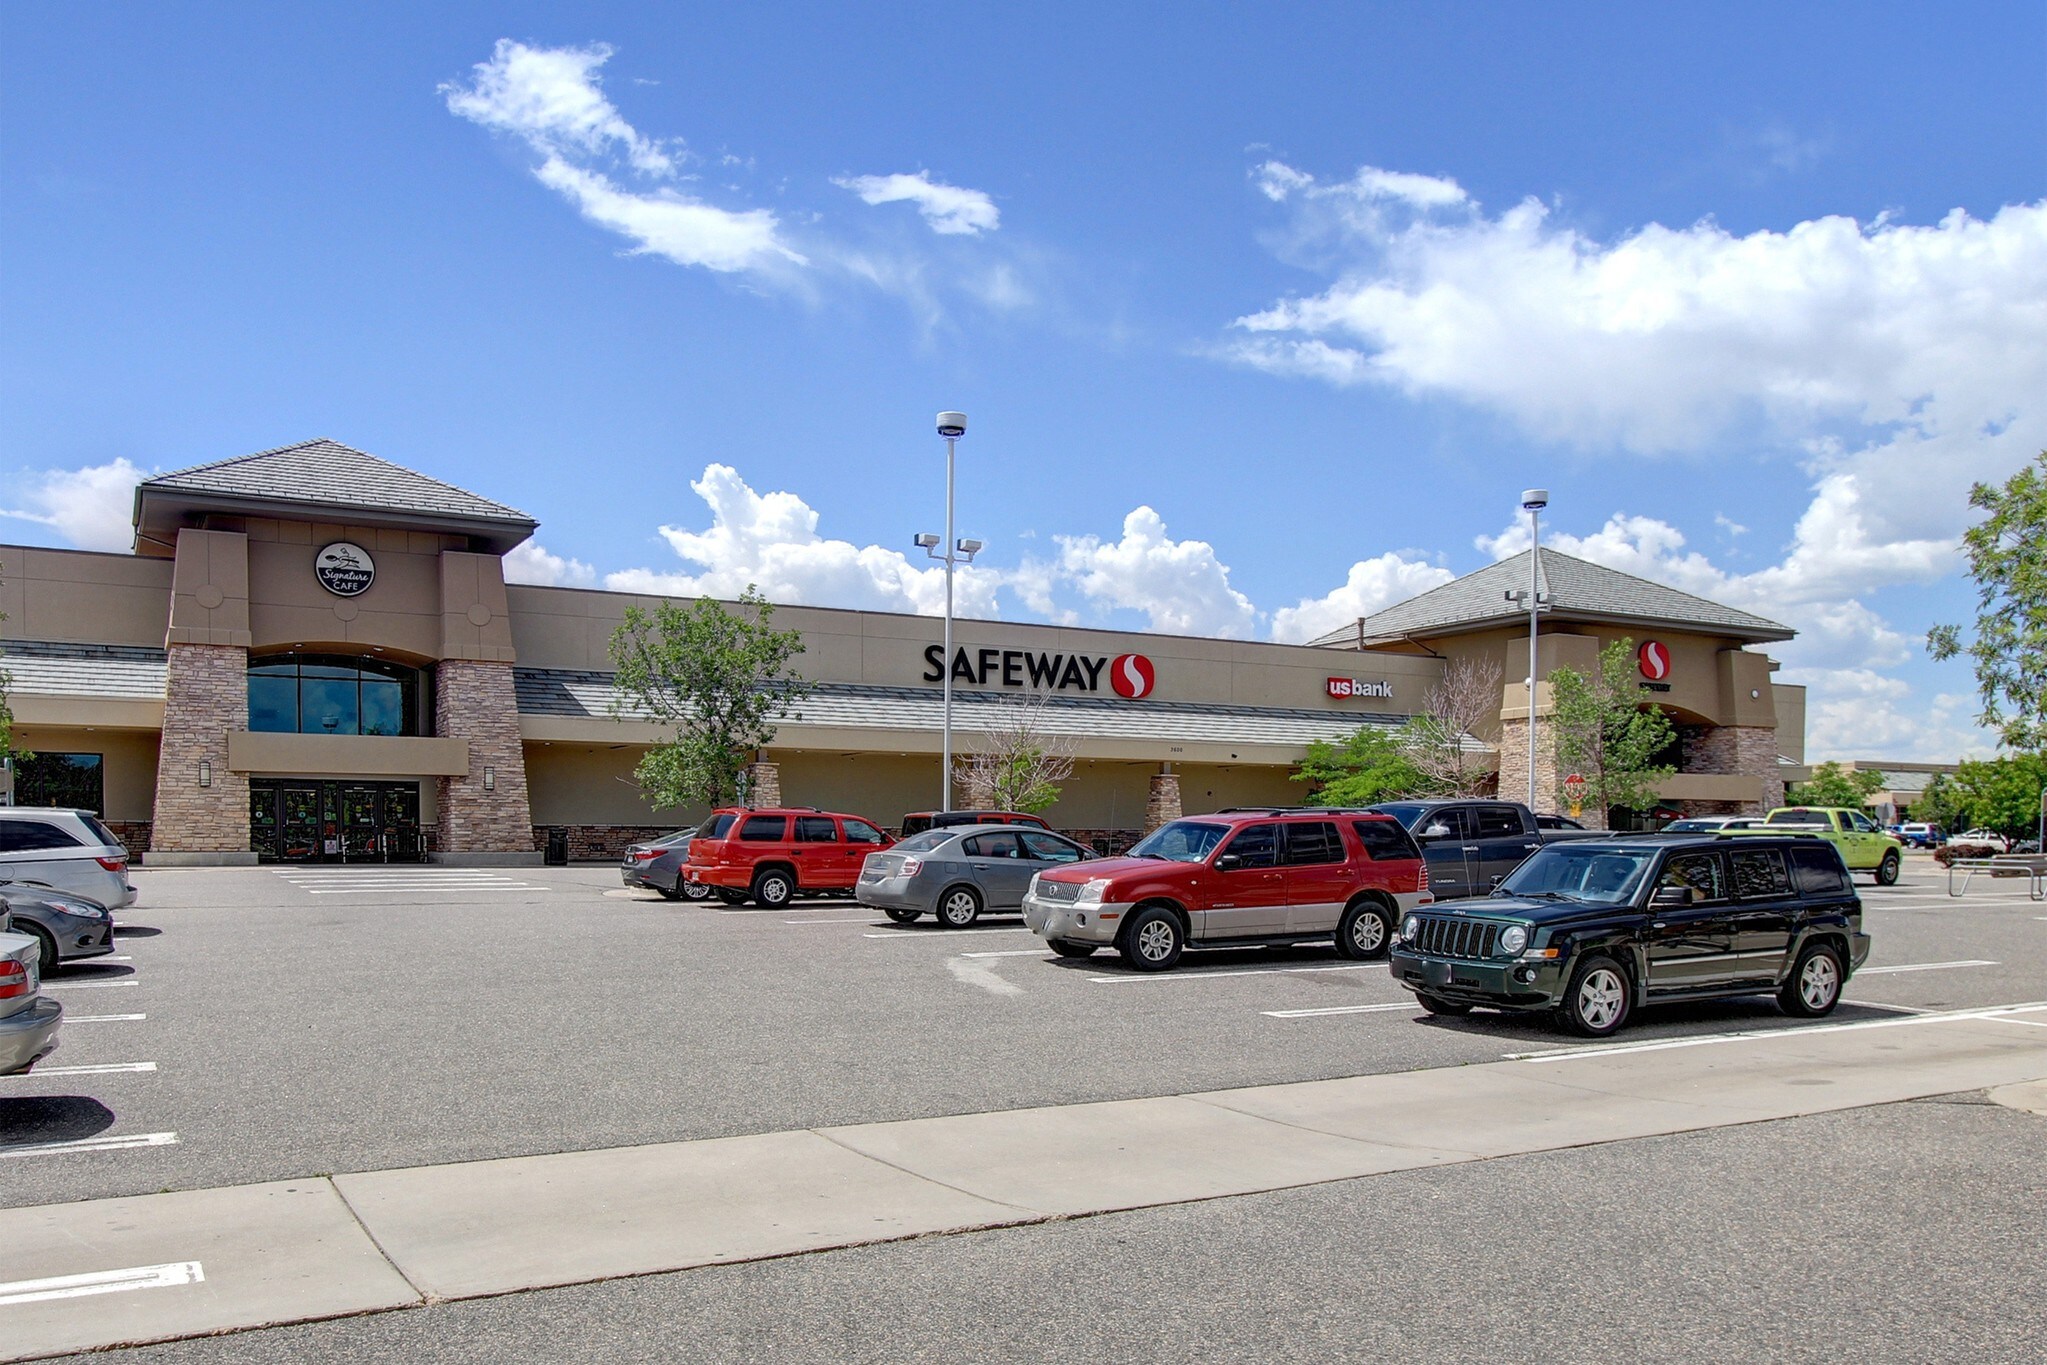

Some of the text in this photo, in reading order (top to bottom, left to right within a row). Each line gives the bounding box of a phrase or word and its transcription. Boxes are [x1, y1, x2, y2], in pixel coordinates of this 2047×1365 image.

[323, 569, 368, 581] Signature
[333, 582, 358, 590] CAFE
[923, 644, 1108, 691] SAFEWAY
